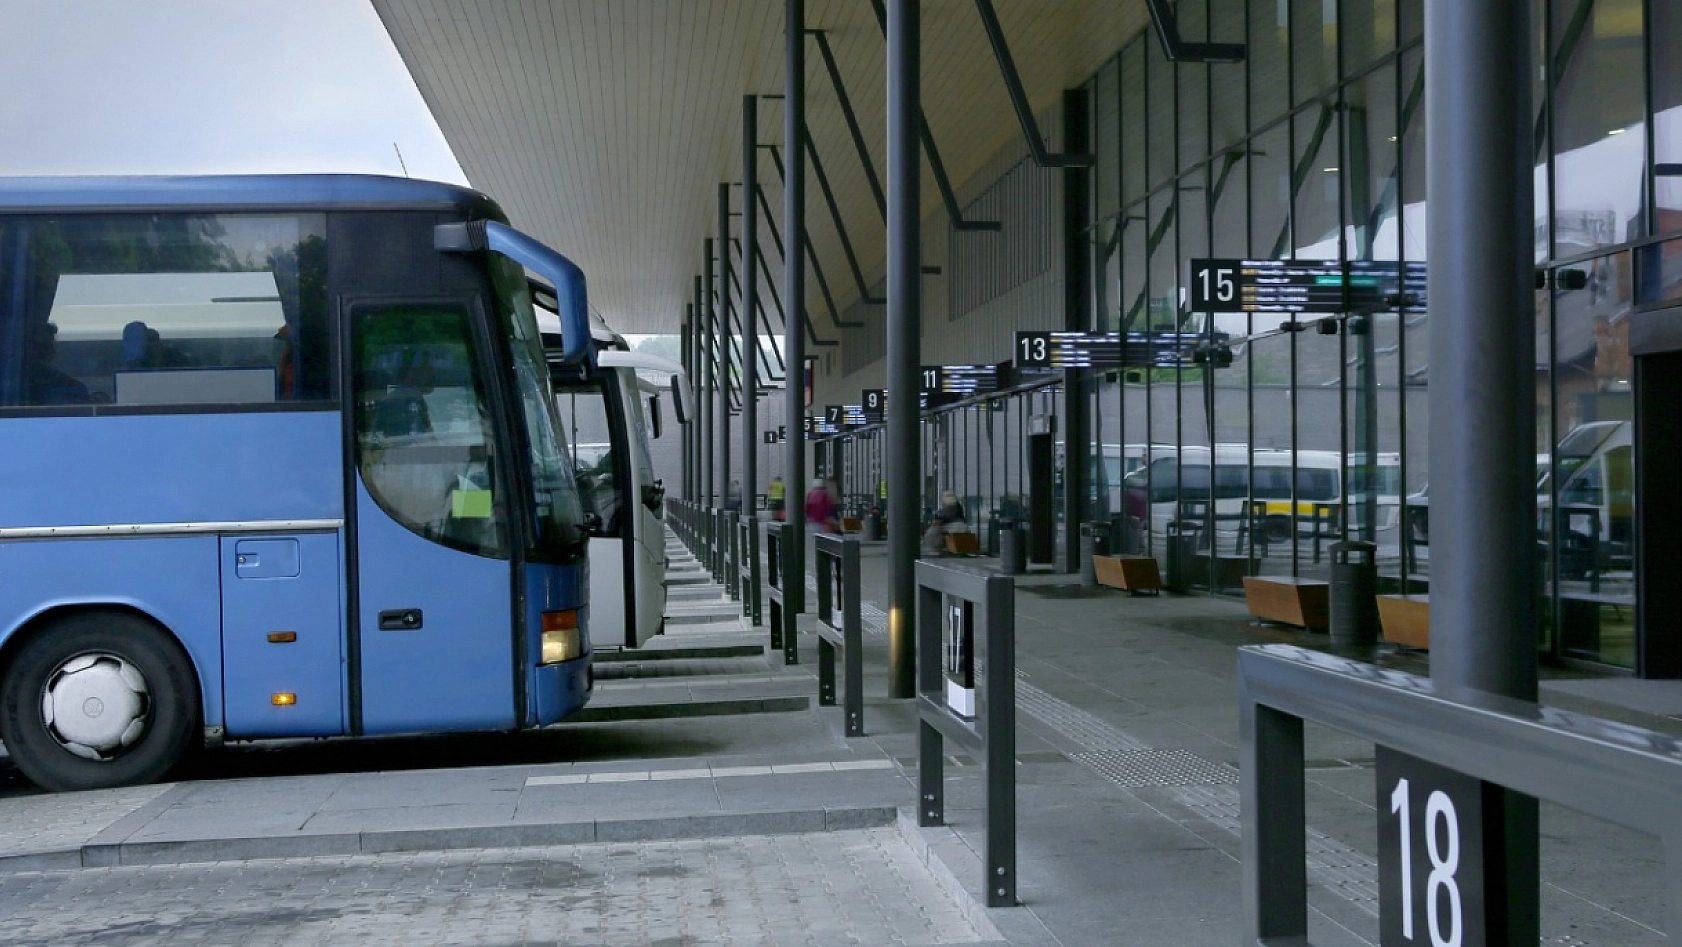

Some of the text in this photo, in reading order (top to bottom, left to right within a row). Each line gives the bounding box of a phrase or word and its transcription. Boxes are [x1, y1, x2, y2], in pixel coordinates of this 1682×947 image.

[1199, 268, 1234, 302] 15
[1021, 337, 1046, 361] 13
[923, 370, 936, 389] 11
[868, 393, 878, 408] 9
[831, 408, 838, 421] 7
[804, 419, 811, 430] 5
[1391, 777, 1464, 947] 18
